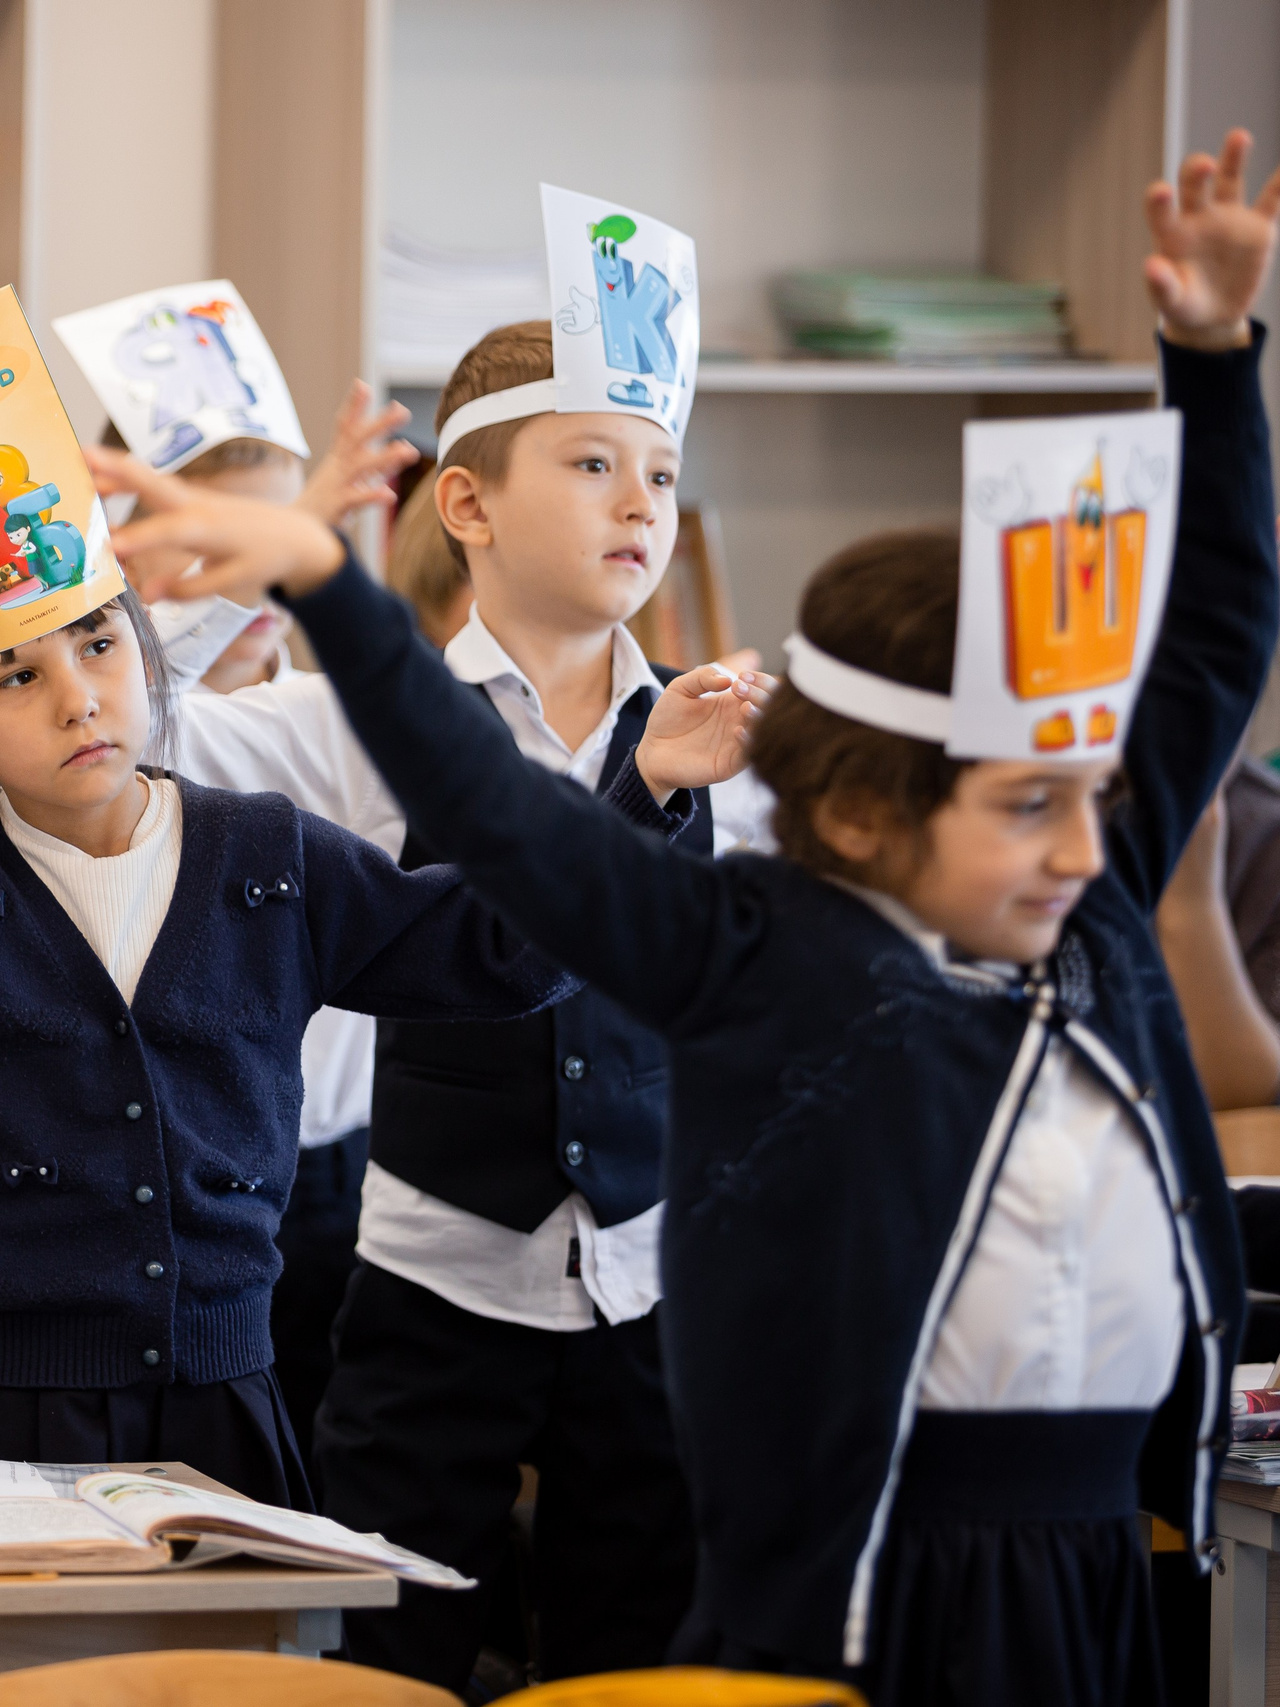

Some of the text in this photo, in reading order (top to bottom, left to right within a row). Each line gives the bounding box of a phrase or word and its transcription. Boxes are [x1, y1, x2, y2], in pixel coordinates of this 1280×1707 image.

[591, 232, 684, 388] К
[5, 482, 87, 586] Б
[1000, 506, 1148, 702] Ш
